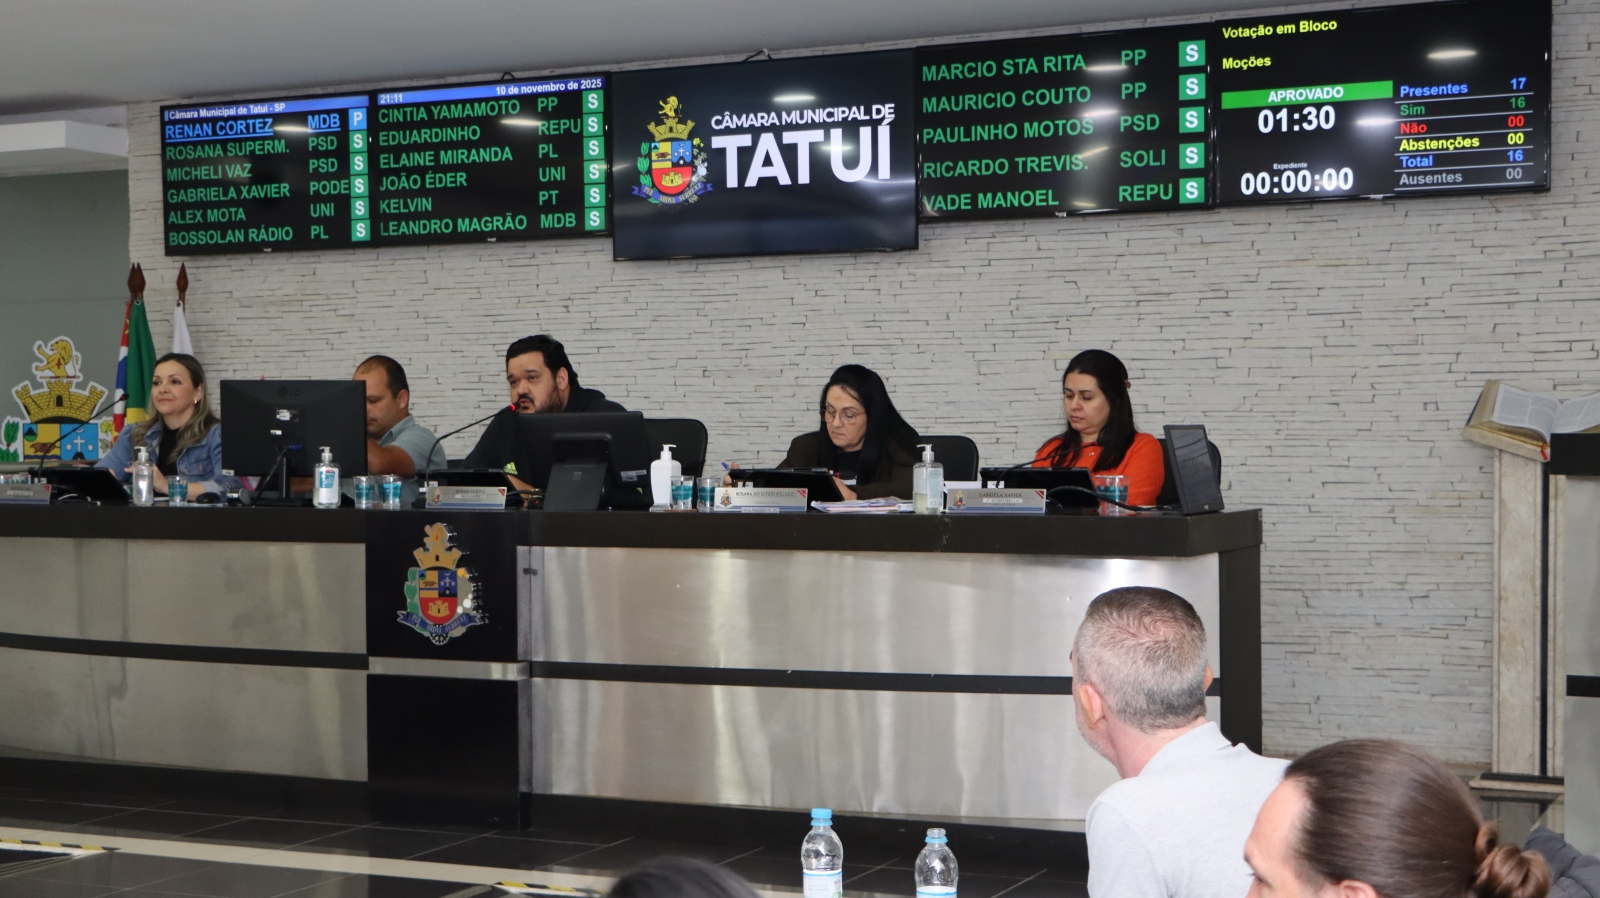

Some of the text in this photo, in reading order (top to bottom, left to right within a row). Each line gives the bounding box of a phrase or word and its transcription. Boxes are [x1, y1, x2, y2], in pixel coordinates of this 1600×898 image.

[1223, 20, 1337, 39] Votação em Bloco
[923, 45, 1198, 81] MARCIO STA RITA PP S
[1223, 56, 1271, 69] Moções
[381, 94, 403, 103] 21:11
[496, 80, 602, 95] 10 de novembro de 2025
[923, 78, 1198, 113] MAURICIO COUTO PP S
[1268, 87, 1344, 103] APROVADO
[1400, 78, 1527, 97] Presentes 17
[169, 111, 198, 119] Câmara
[200, 107, 236, 118] Municipal
[238, 107, 248, 115] de
[274, 104, 285, 112] SP
[379, 94, 598, 123] CINTIA YAMAMOTO PP S
[711, 104, 895, 129] CÂMARA MUNICIPAL DE
[1400, 97, 1526, 116] Sim 16
[166, 112, 362, 139] RENAN CORTEZ MDB P
[379, 117, 598, 145] EDUARDINHO REPU S
[923, 111, 1198, 144] PAULINHO MOTOS PSD S
[1258, 106, 1336, 133] 01:30
[1400, 116, 1524, 134] Não 00
[167, 134, 362, 160] ROSANA SUPERM. PSD S
[380, 141, 599, 168] ELAINE MIRANDA PL S
[711, 118, 894, 188] TATUÍ
[1400, 133, 1524, 152] Abstenções 00
[167, 157, 363, 181] MICHELI VAZ PSD S
[924, 147, 1198, 178] RICARDO TREVIS. SOLI S
[1273, 162, 1307, 170] Expediente
[1400, 151, 1523, 168] Total 16
[380, 165, 599, 190] JOÃO ÉDER UNI S
[1240, 167, 1353, 195] 00:00:00
[1400, 168, 1522, 186] Ausentes 00
[168, 179, 364, 203] GABRIELA XAVIER PODE S
[380, 188, 600, 213] KELVIN PT S
[924, 182, 1198, 211] VADE MANOEL REPU S
[168, 201, 364, 224] ALEX MOTA UNI S
[380, 212, 600, 236] LEANDRO MAGRÃO MDB S
[170, 223, 365, 246] BOSSOLAN RÁDIO PL S
